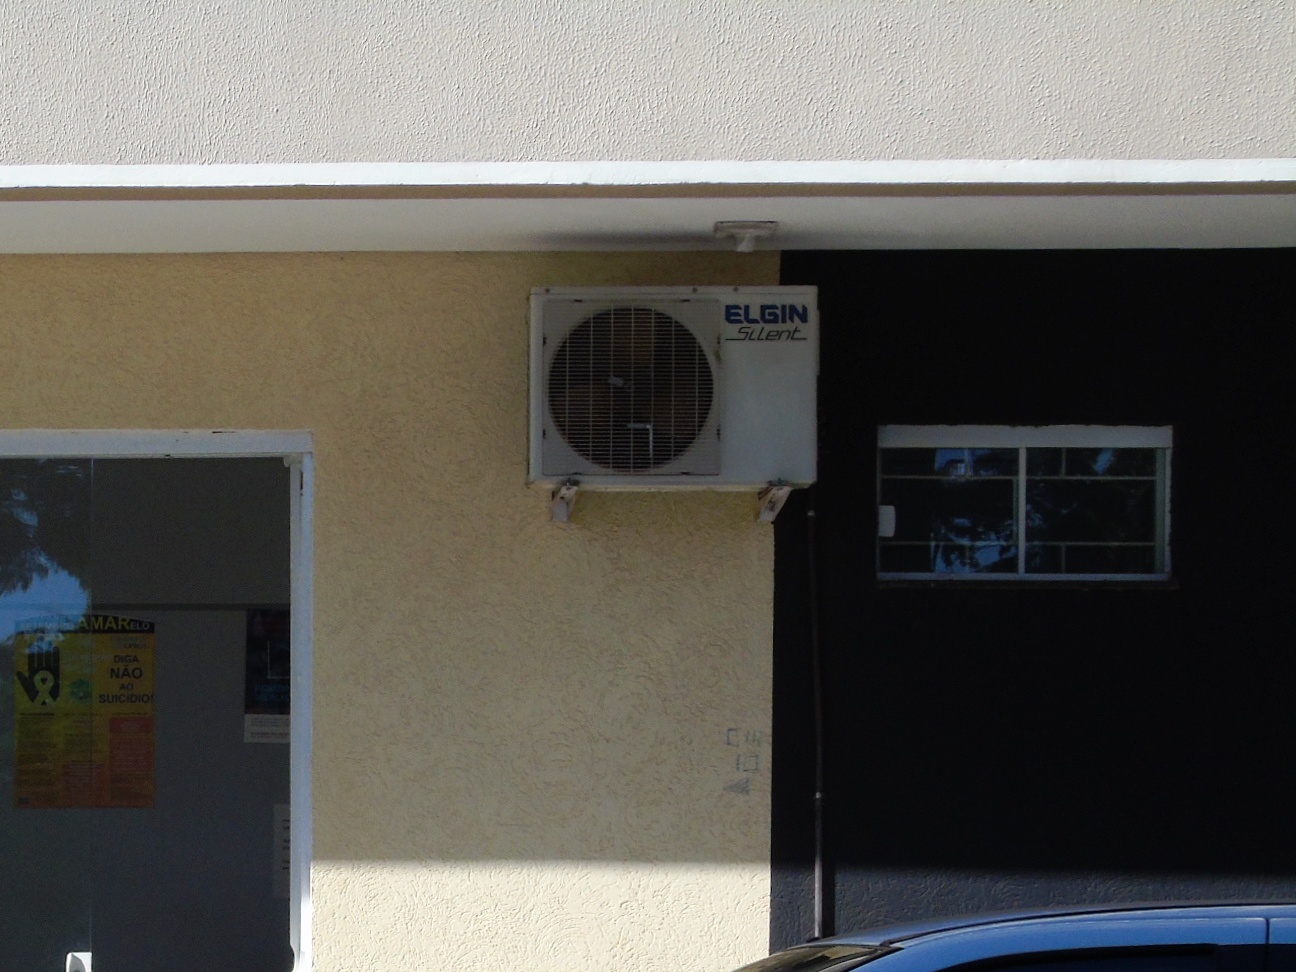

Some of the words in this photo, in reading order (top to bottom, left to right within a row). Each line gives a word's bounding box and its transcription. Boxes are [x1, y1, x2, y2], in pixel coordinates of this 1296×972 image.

[725, 304, 808, 324] ELGIN
[725, 326, 807, 341] Silent
[78, 615, 150, 630] AMARELO
[114, 655, 139, 664] DIGA
[111, 665, 143, 679] NÃO
[119, 683, 134, 691] AO
